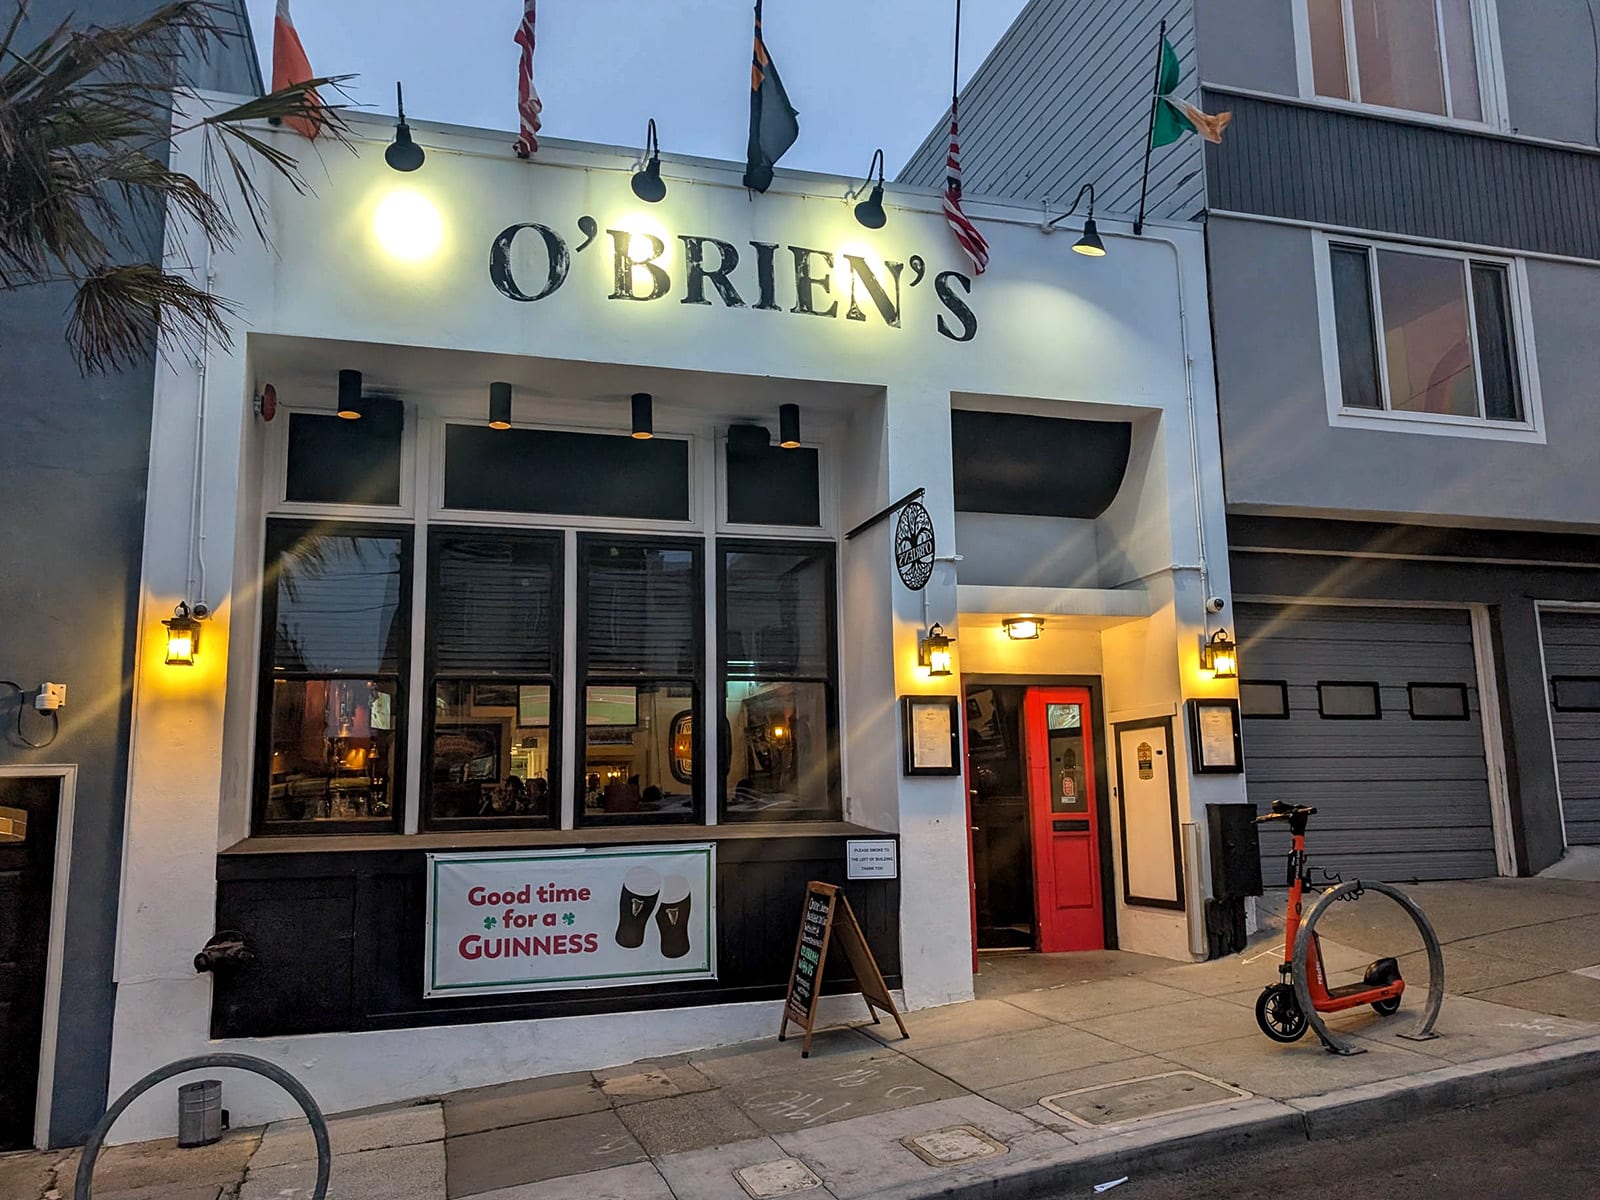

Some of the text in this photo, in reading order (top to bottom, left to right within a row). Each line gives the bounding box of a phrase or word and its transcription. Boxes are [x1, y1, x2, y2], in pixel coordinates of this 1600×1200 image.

[489, 215, 978, 342] O'BRIEN'S
[467, 882, 591, 907] Good time
[502, 908, 557, 929] for a
[458, 933, 599, 961] GUINNESS
